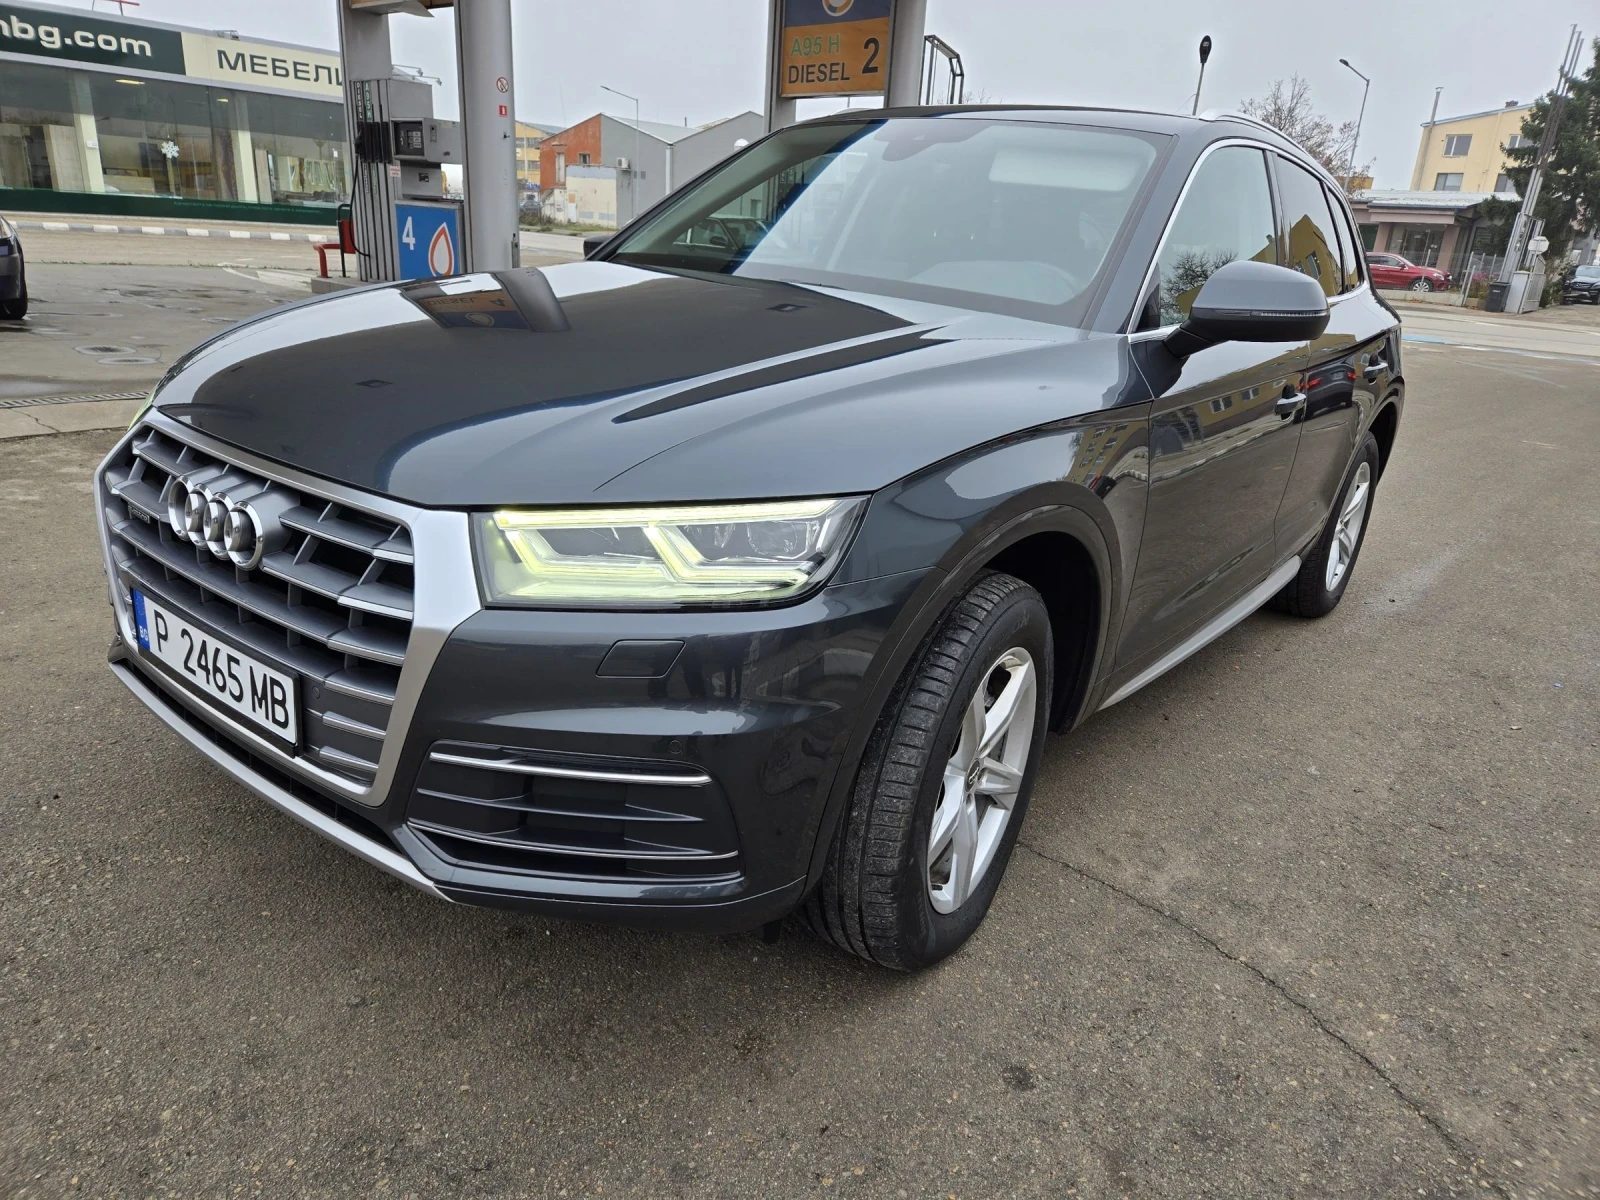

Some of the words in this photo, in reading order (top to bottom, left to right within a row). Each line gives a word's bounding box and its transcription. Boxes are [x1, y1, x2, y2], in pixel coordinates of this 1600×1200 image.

[790, 35, 823, 57] A95
[828, 34, 840, 54] H
[861, 37, 880, 75] 2
[788, 62, 851, 84] DIESEL
[402, 215, 416, 251] 4
[153, 609, 168, 652] P
[180, 628, 244, 703] 2465
[249, 665, 289, 730] MB
